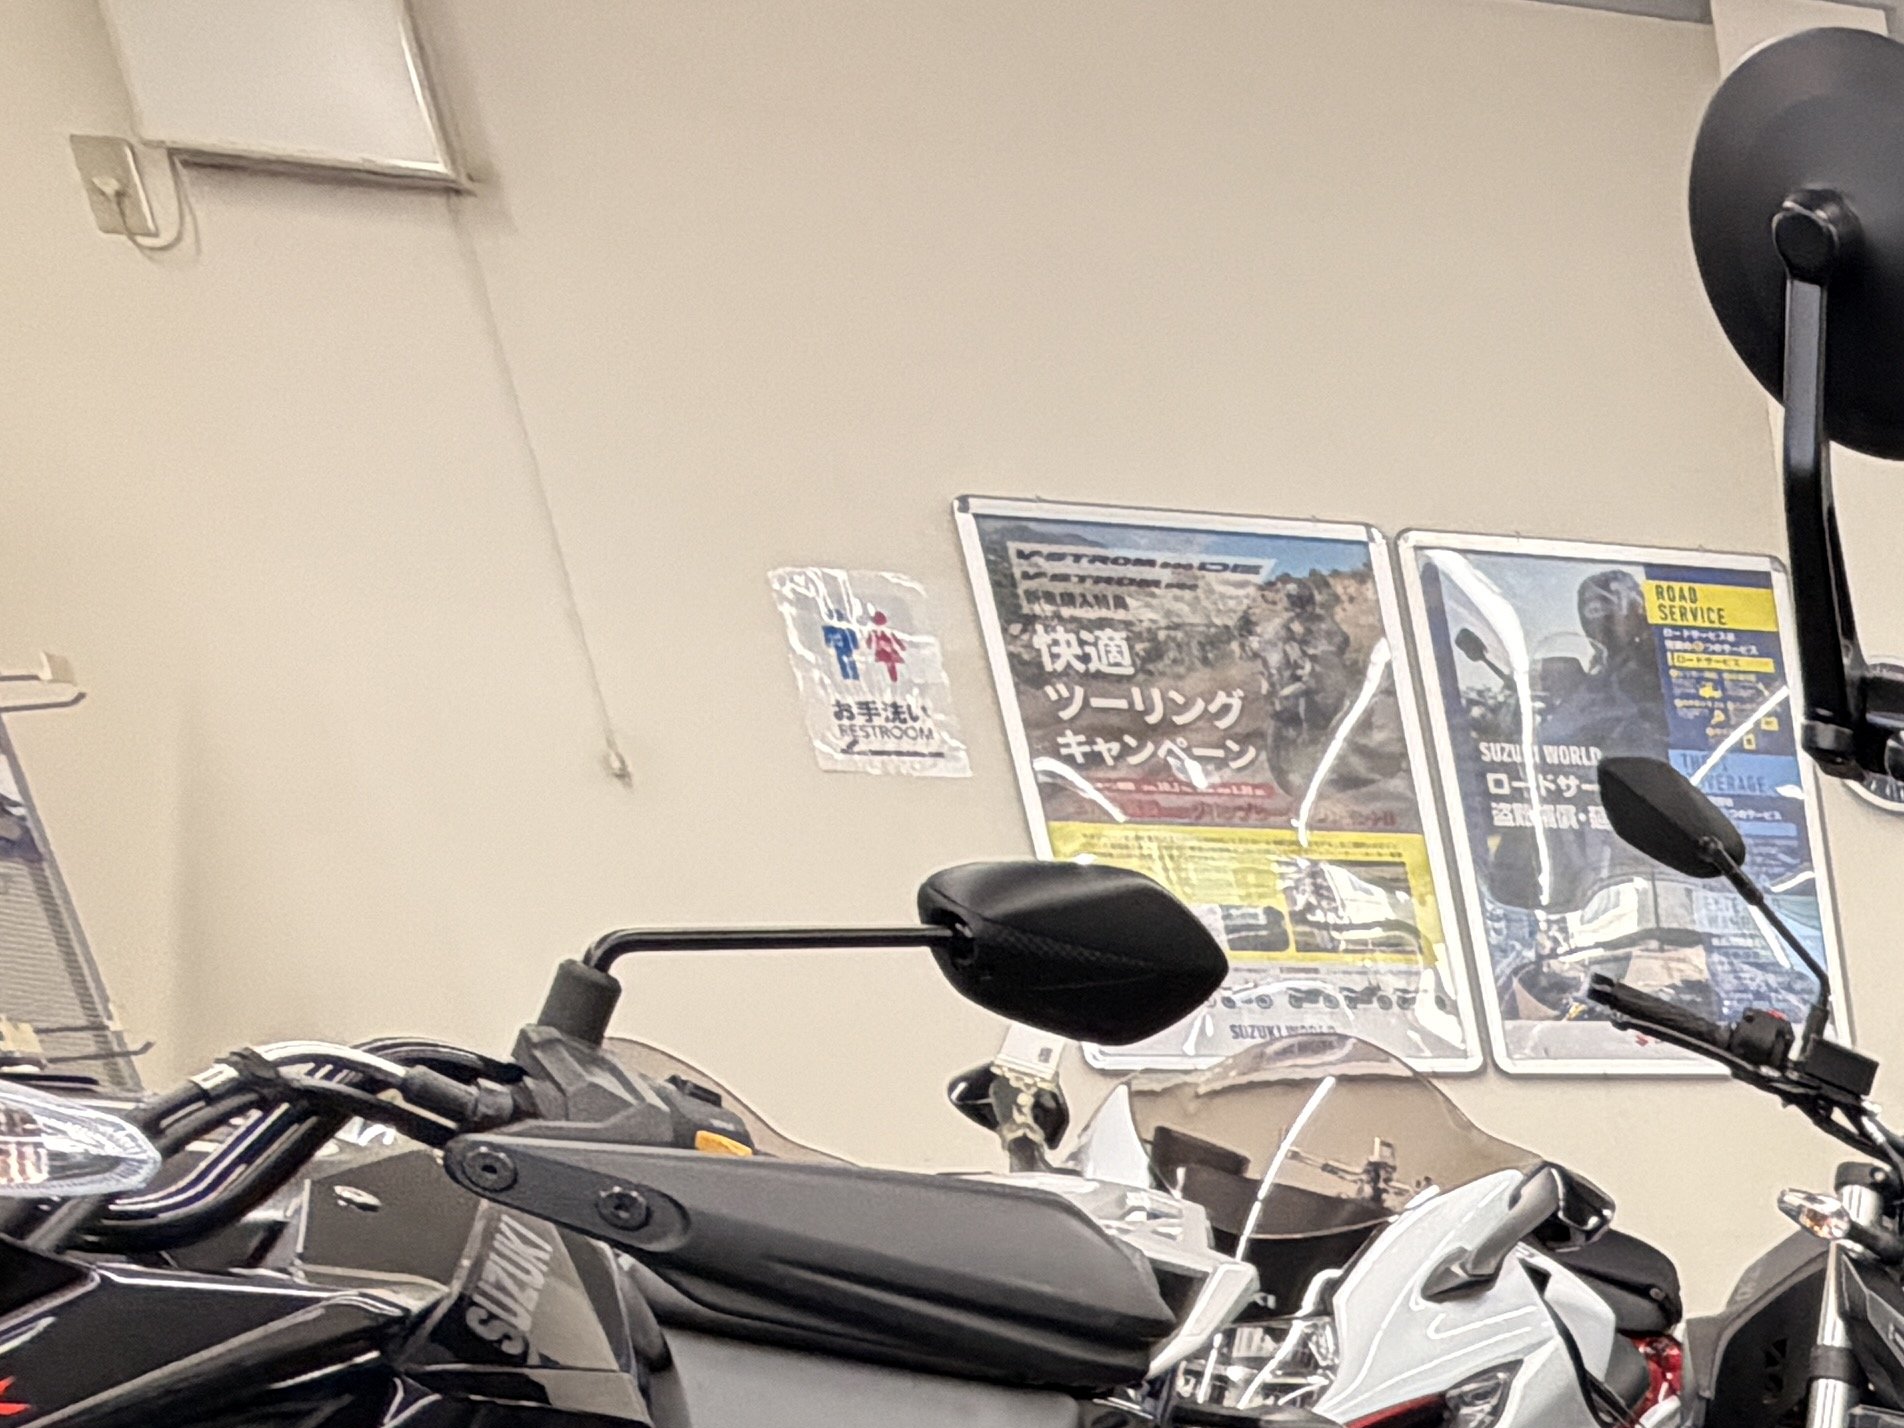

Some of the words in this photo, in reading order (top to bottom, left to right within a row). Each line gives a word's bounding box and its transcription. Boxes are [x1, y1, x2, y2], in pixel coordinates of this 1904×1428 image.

[1655, 584, 1699, 604] ROAD
[1658, 603, 1727, 625] SERVICE
[1033, 624, 1135, 675] 快適
[832, 700, 932, 723] お手洗い
[1044, 682, 1245, 730] ツーリング
[838, 724, 934, 741] RESTROOM
[1056, 729, 1257, 770] キャンペーン
[466, 1214, 553, 1355] SUZUKI
